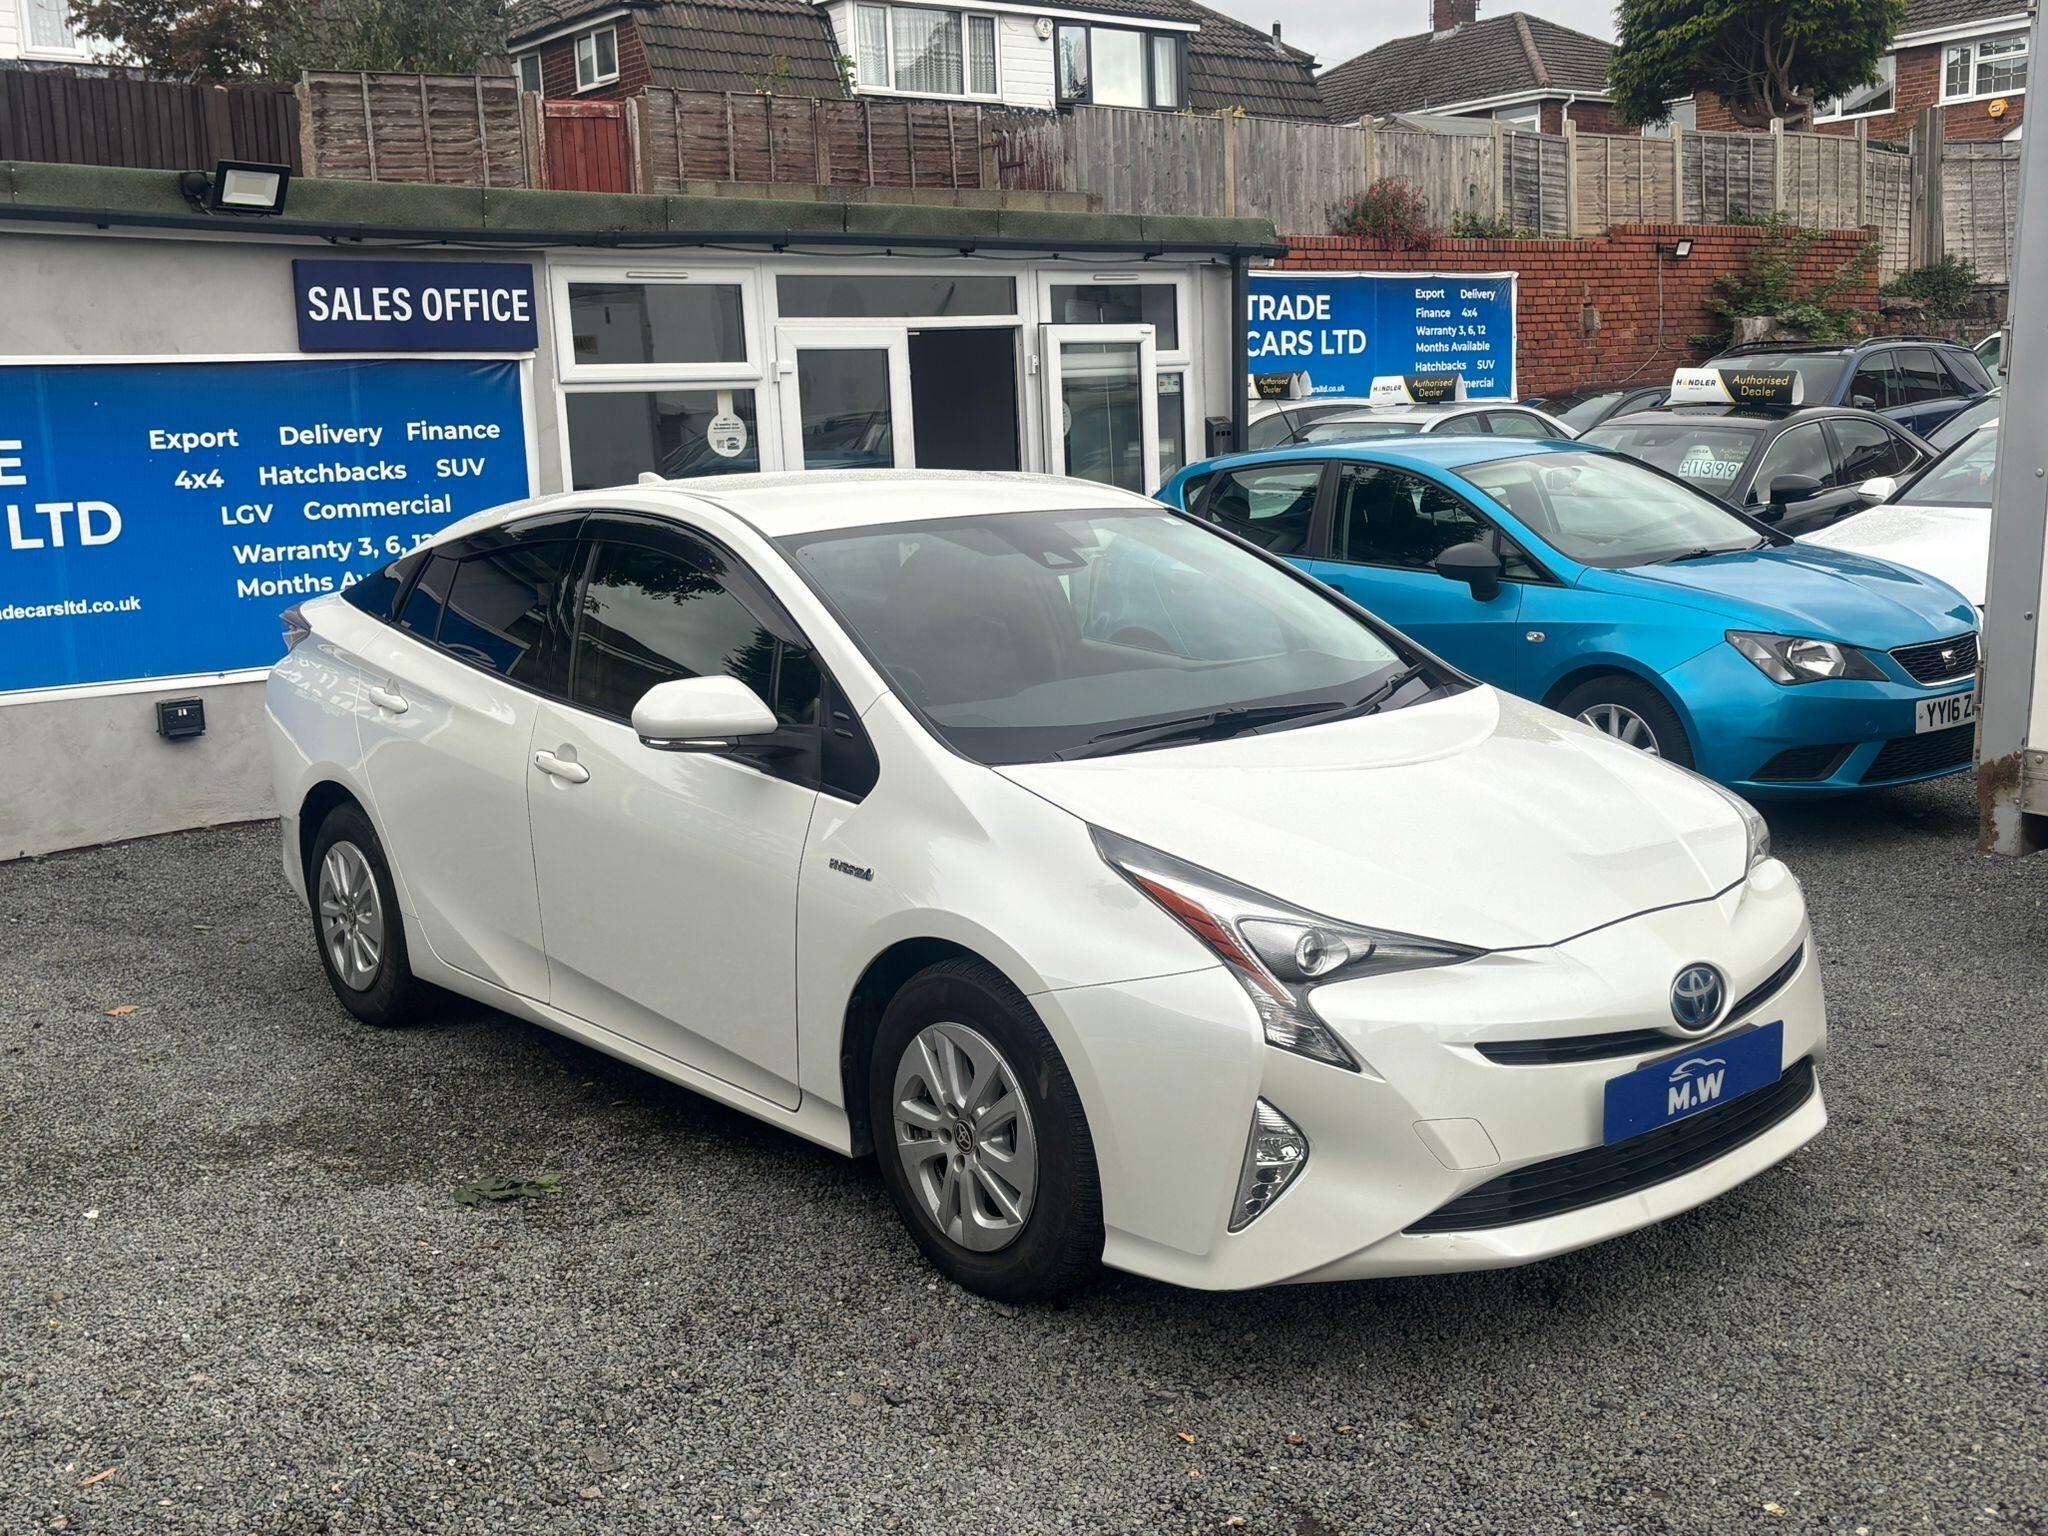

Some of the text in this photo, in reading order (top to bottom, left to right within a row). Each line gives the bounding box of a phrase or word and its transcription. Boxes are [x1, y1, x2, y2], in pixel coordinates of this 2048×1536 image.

[308, 286, 530, 322] SALES OFFICE
[1247, 294, 1331, 321] TRADE
[1415, 288, 1496, 301] Export Delivery
[1415, 307, 1478, 318] Finance 4x4
[1247, 329, 1367, 357] CARS LTD
[1415, 325, 1486, 338] Warranty 3, 6, 12
[1415, 340, 1491, 353] Months Available
[1415, 359, 1496, 372] Hatchbacks SUV
[1412, 378, 1454, 388] Authorised
[1418, 388, 1444, 397] Dealer
[1731, 374, 1790, 386] Authorised
[1740, 386, 1776, 397] Dealer
[149, 420, 501, 454] Export Delivery Finance
[174, 457, 486, 490] 4x4 Hatchbacks SUV
[221, 493, 452, 526] LGV Commercial
[6, 501, 123, 550] LTD
[232, 539, 352, 565] Warranty
[357, 537, 379, 559] 3,
[385, 535, 407, 558] 6,
[236, 573, 334, 598] Months
[1926, 693, 1975, 727] YY16 Z
[1668, 1068, 1725, 1116] M.W
